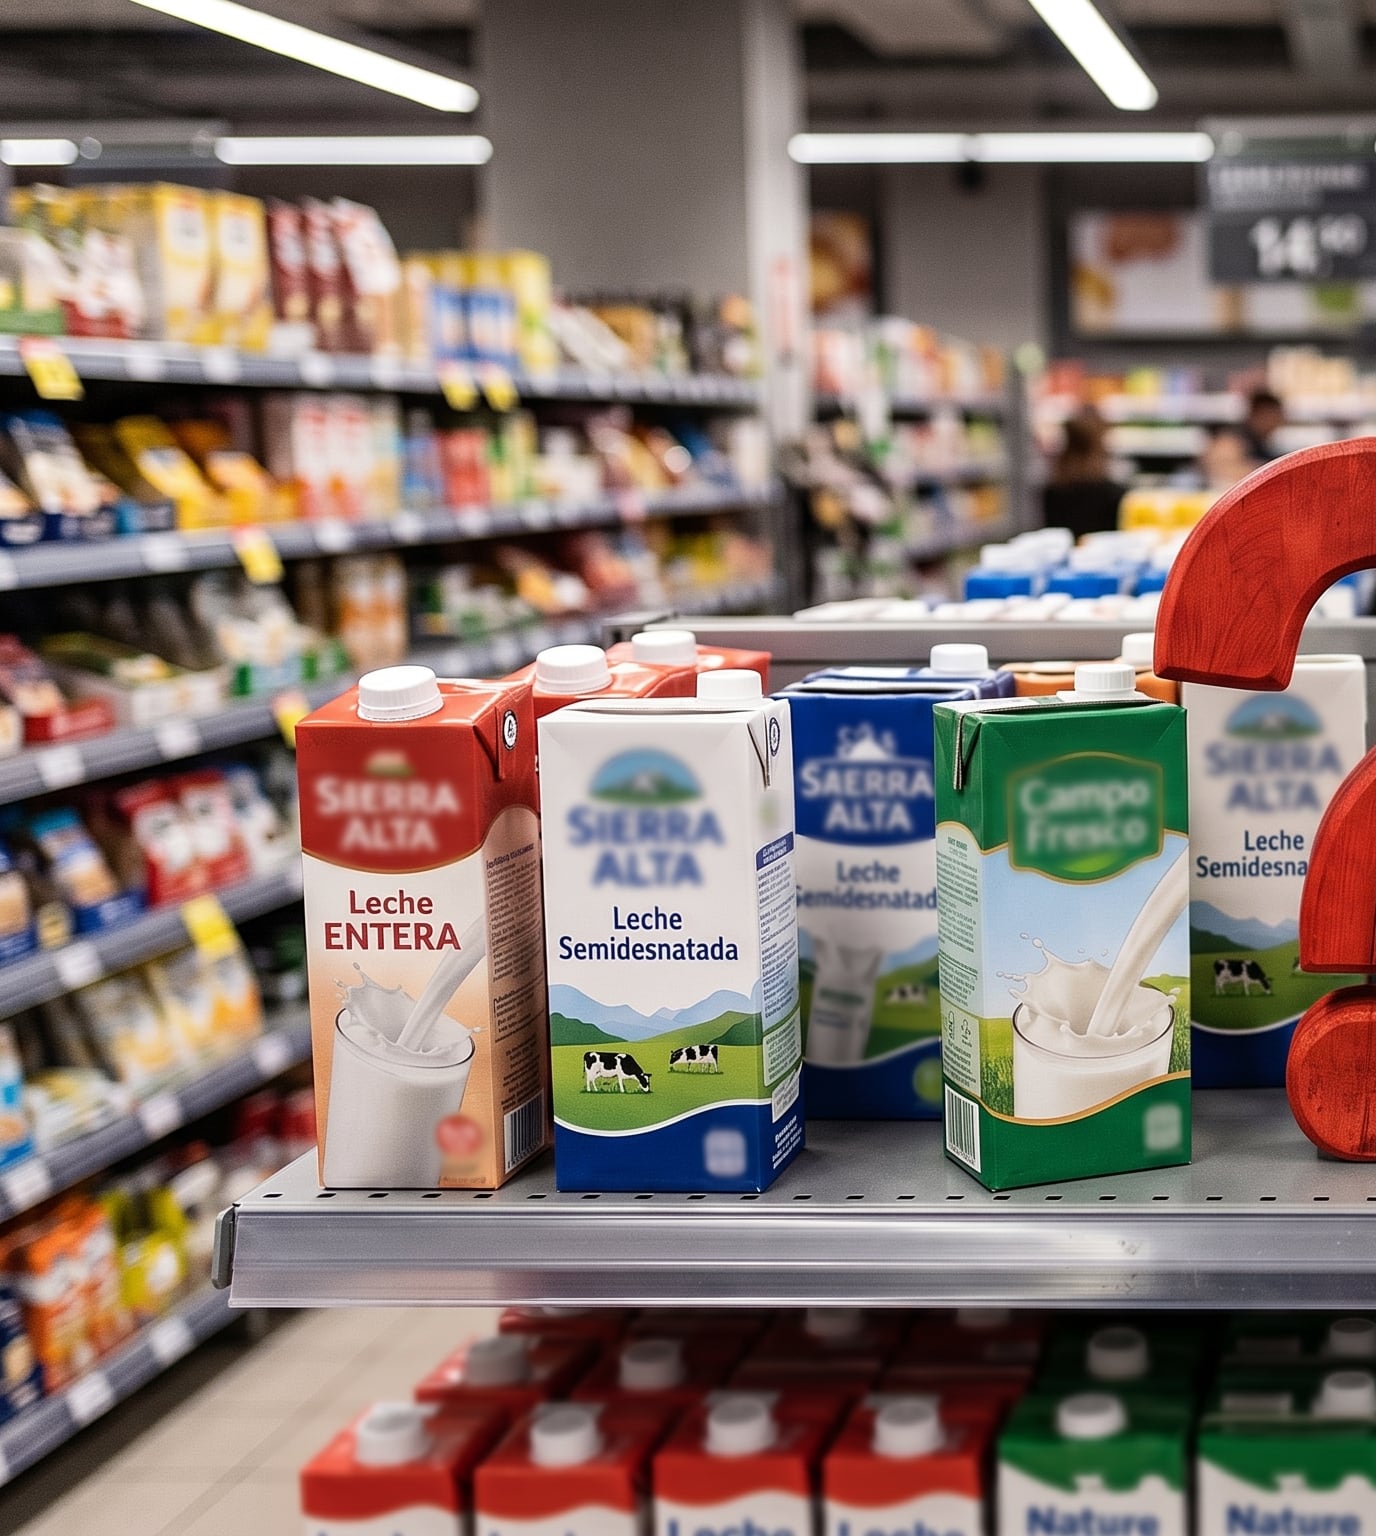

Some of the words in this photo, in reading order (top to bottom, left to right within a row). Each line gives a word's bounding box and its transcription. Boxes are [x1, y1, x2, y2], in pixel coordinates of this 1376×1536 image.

[1206, 743, 1342, 777] SIERRA
[315, 774, 461, 817] SIERRA
[1020, 779, 1149, 819] Campo
[1227, 781, 1321, 812] ALTA
[566, 805, 726, 846] SIERRA
[825, 802, 912, 832] ALTA
[341, 817, 438, 850] ALTA
[1026, 817, 1148, 853] Fresco
[1244, 830, 1304, 851] Leche
[592, 849, 704, 888] ALTA
[836, 861, 899, 883] Leche
[1196, 856, 1308, 878] Semidesna
[350, 890, 433, 914] Leche
[613, 906, 682, 930] Leche
[325, 923, 461, 950] ENTERA
[559, 936, 738, 961] Semidesnatada
[1026, 1504, 1159, 1536] Nature
[1226, 1504, 1360, 1536] Nature
